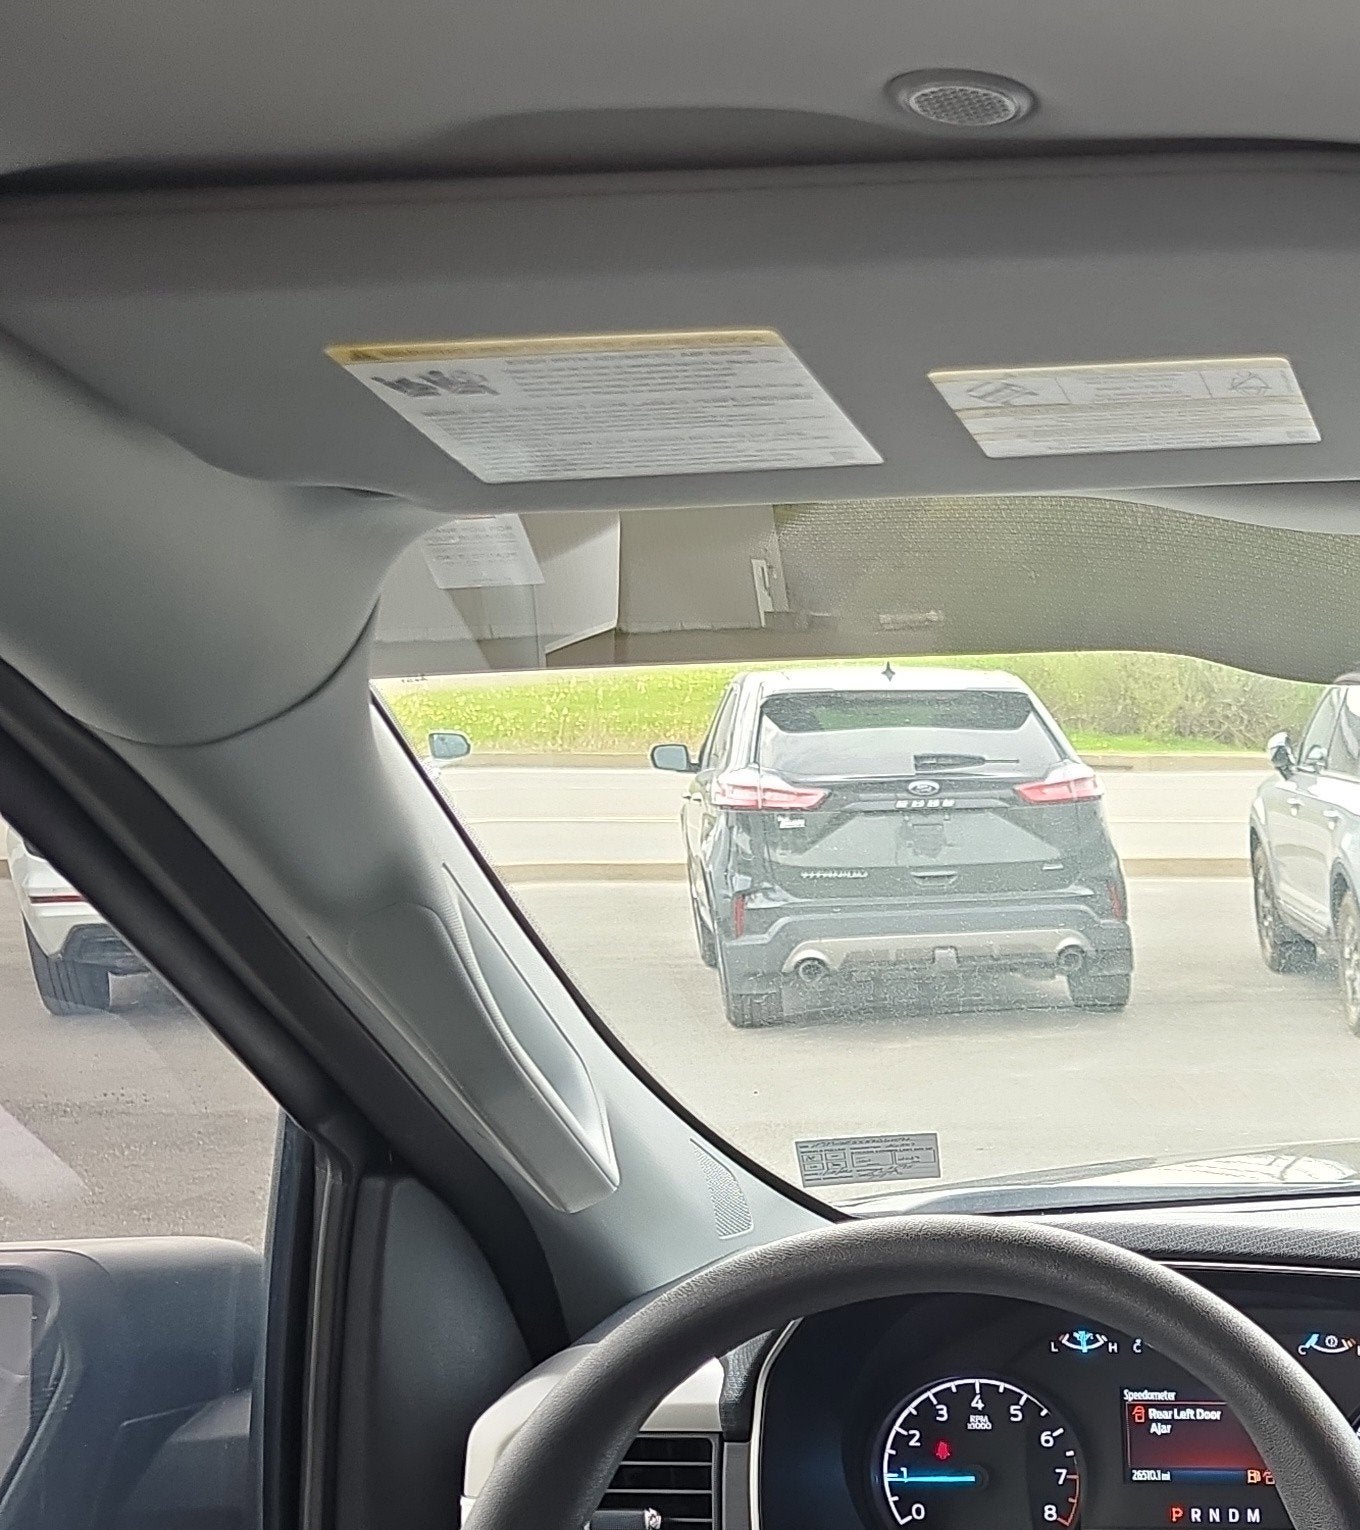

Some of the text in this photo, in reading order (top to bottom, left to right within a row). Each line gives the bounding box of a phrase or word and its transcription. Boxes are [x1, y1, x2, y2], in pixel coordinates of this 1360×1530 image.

[1108, 1342, 1118, 1353] H
[971, 1394, 985, 1410] 4
[1123, 1389, 1176, 1402] Speedometer
[936, 1405, 948, 1421] 3
[969, 1415, 989, 1423] RPM
[1009, 1405, 1023, 1422] 5
[1148, 1408, 1222, 1420] Rear Left Door
[1150, 1423, 1172, 1436] Ajar
[908, 1430, 921, 1446] 2
[1040, 1431, 1055, 1447] 6
[1055, 1468, 1068, 1485] 7
[911, 1503, 925, 1520] 0
[1043, 1504, 1058, 1521] 8
[1171, 1507, 1261, 1522] P R N D M
